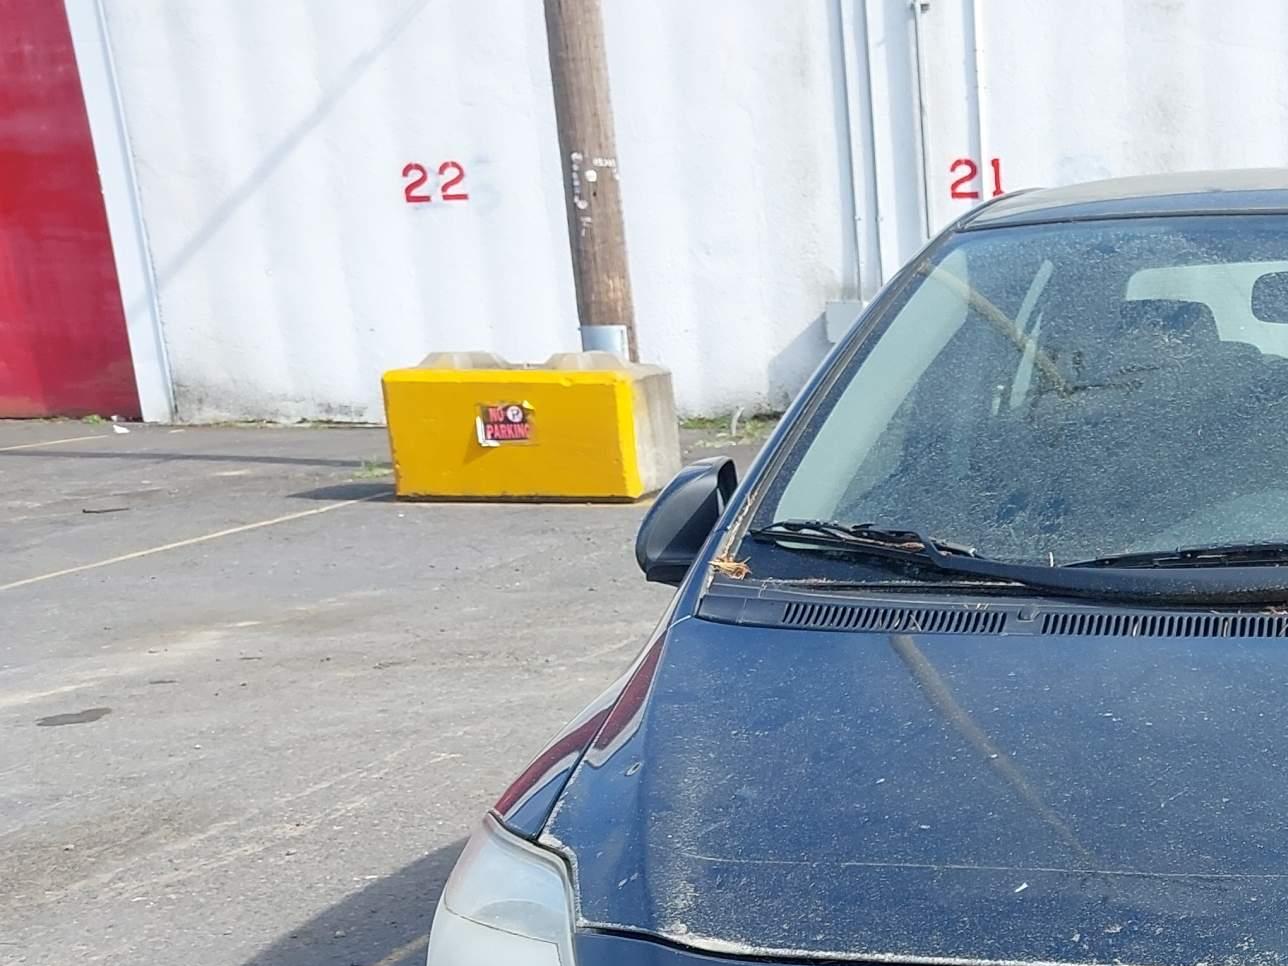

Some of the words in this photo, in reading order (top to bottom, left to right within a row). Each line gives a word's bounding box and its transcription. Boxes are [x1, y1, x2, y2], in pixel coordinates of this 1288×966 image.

[401, 161, 469, 203] 22
[949, 158, 1004, 199] 21
[488, 406, 505, 422] NO
